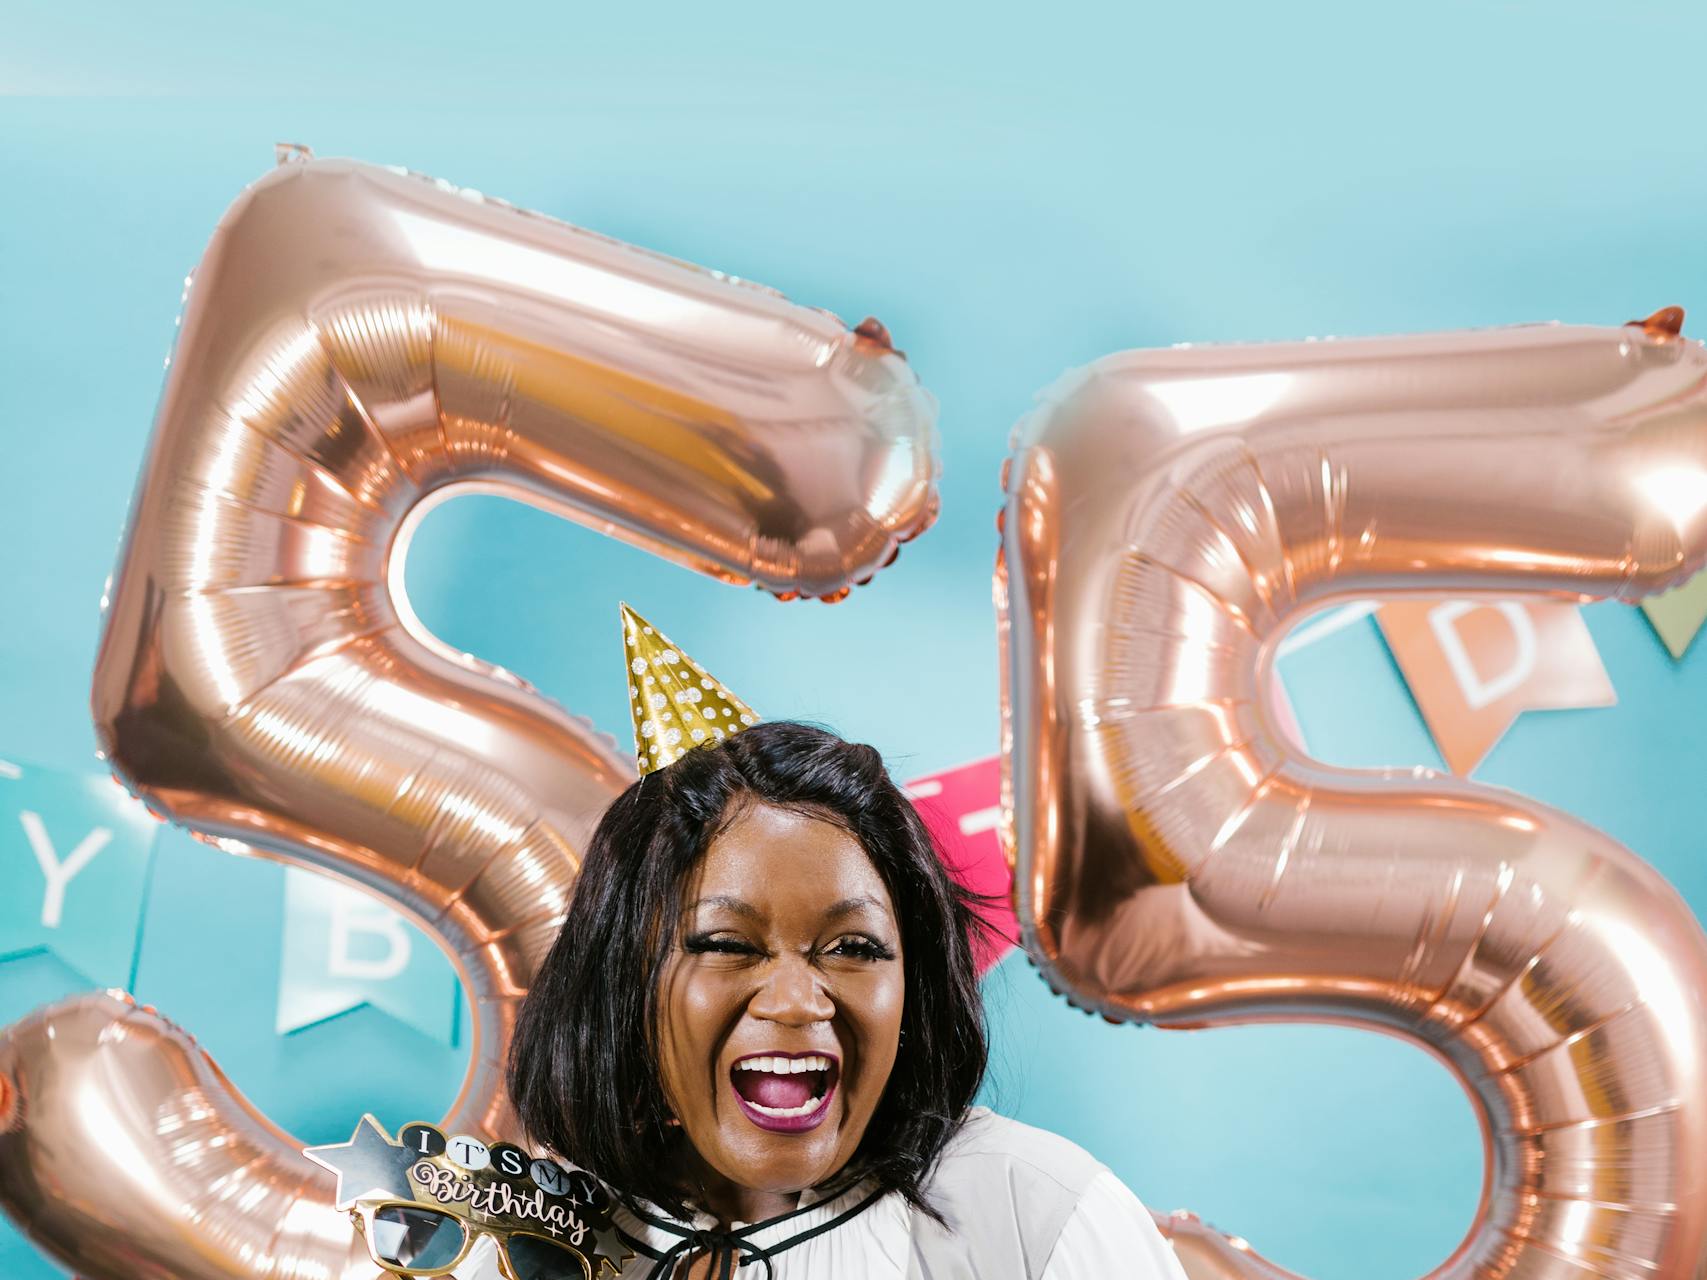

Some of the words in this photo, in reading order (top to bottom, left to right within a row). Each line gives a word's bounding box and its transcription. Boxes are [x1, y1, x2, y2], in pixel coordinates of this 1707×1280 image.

[1428, 600, 1536, 711] D
[20, 811, 113, 928] Y
[330, 887, 412, 981] B
[411, 1161, 590, 1246] Birthday
[537, 1163, 598, 1205] MY
